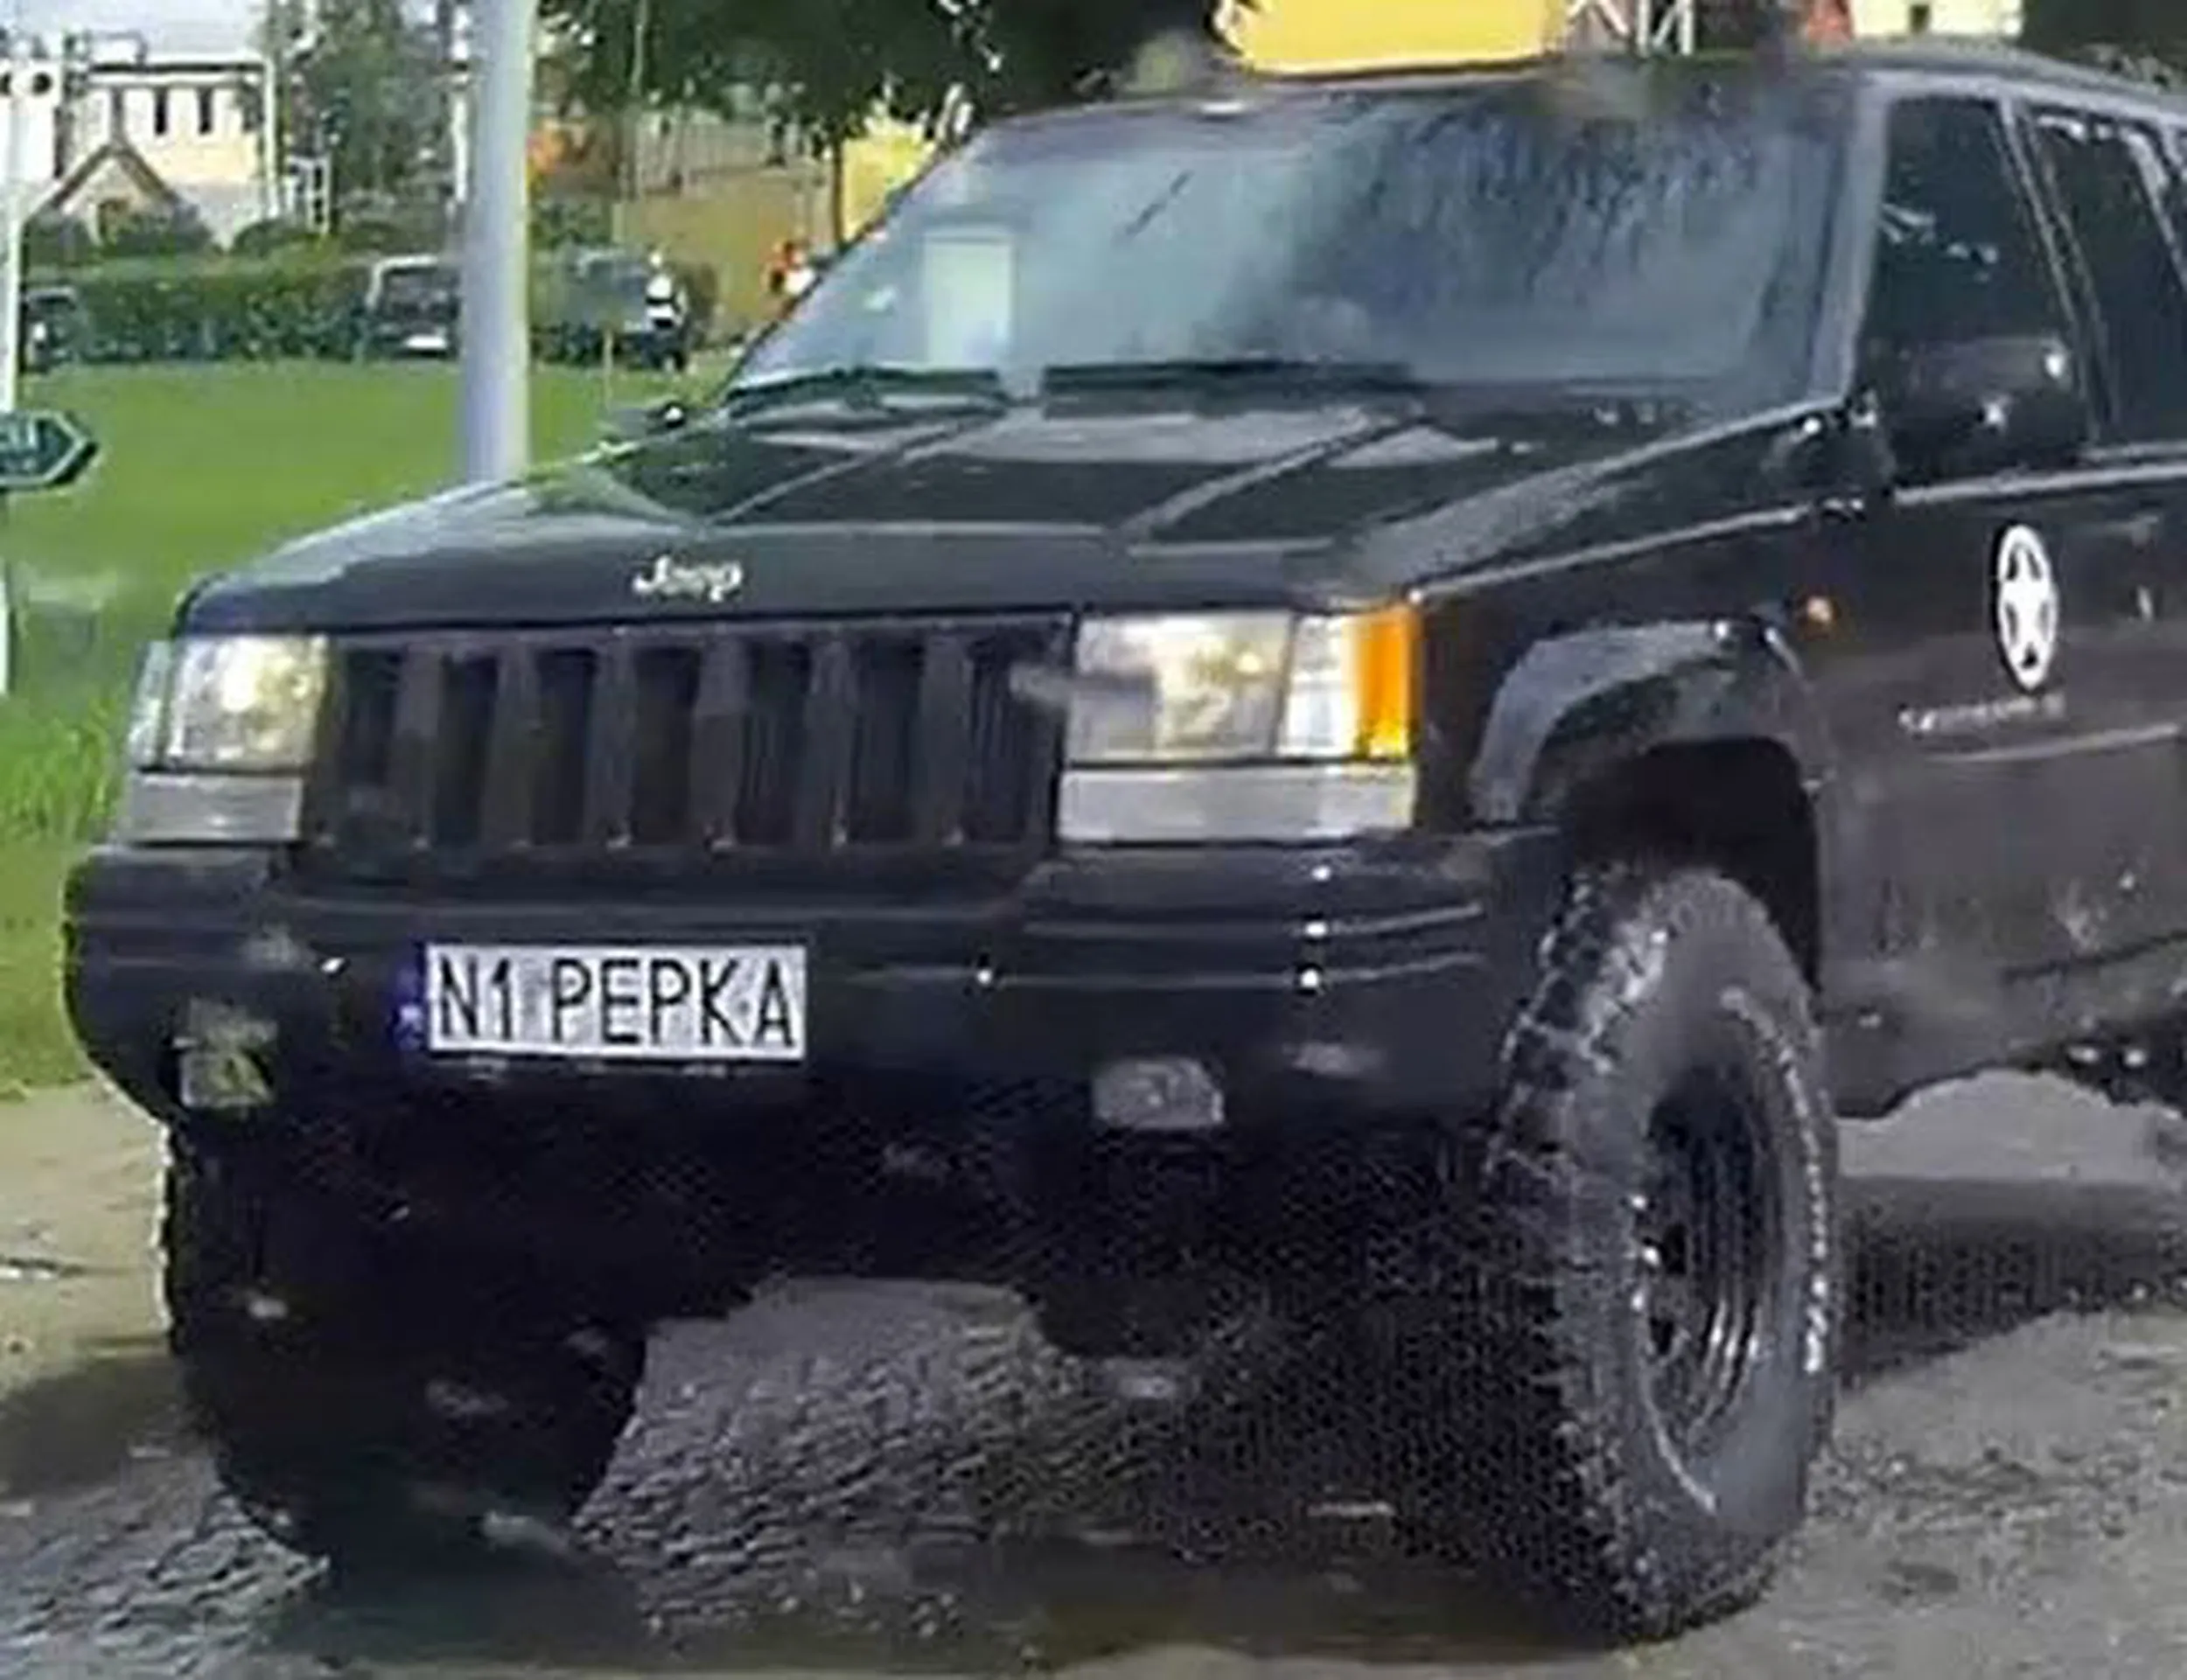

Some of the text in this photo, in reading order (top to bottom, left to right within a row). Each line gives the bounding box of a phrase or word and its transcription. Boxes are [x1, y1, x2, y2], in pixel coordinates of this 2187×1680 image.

[632, 554, 743, 602] Jeep
[440, 956, 794, 1048] N1 PEPKA
